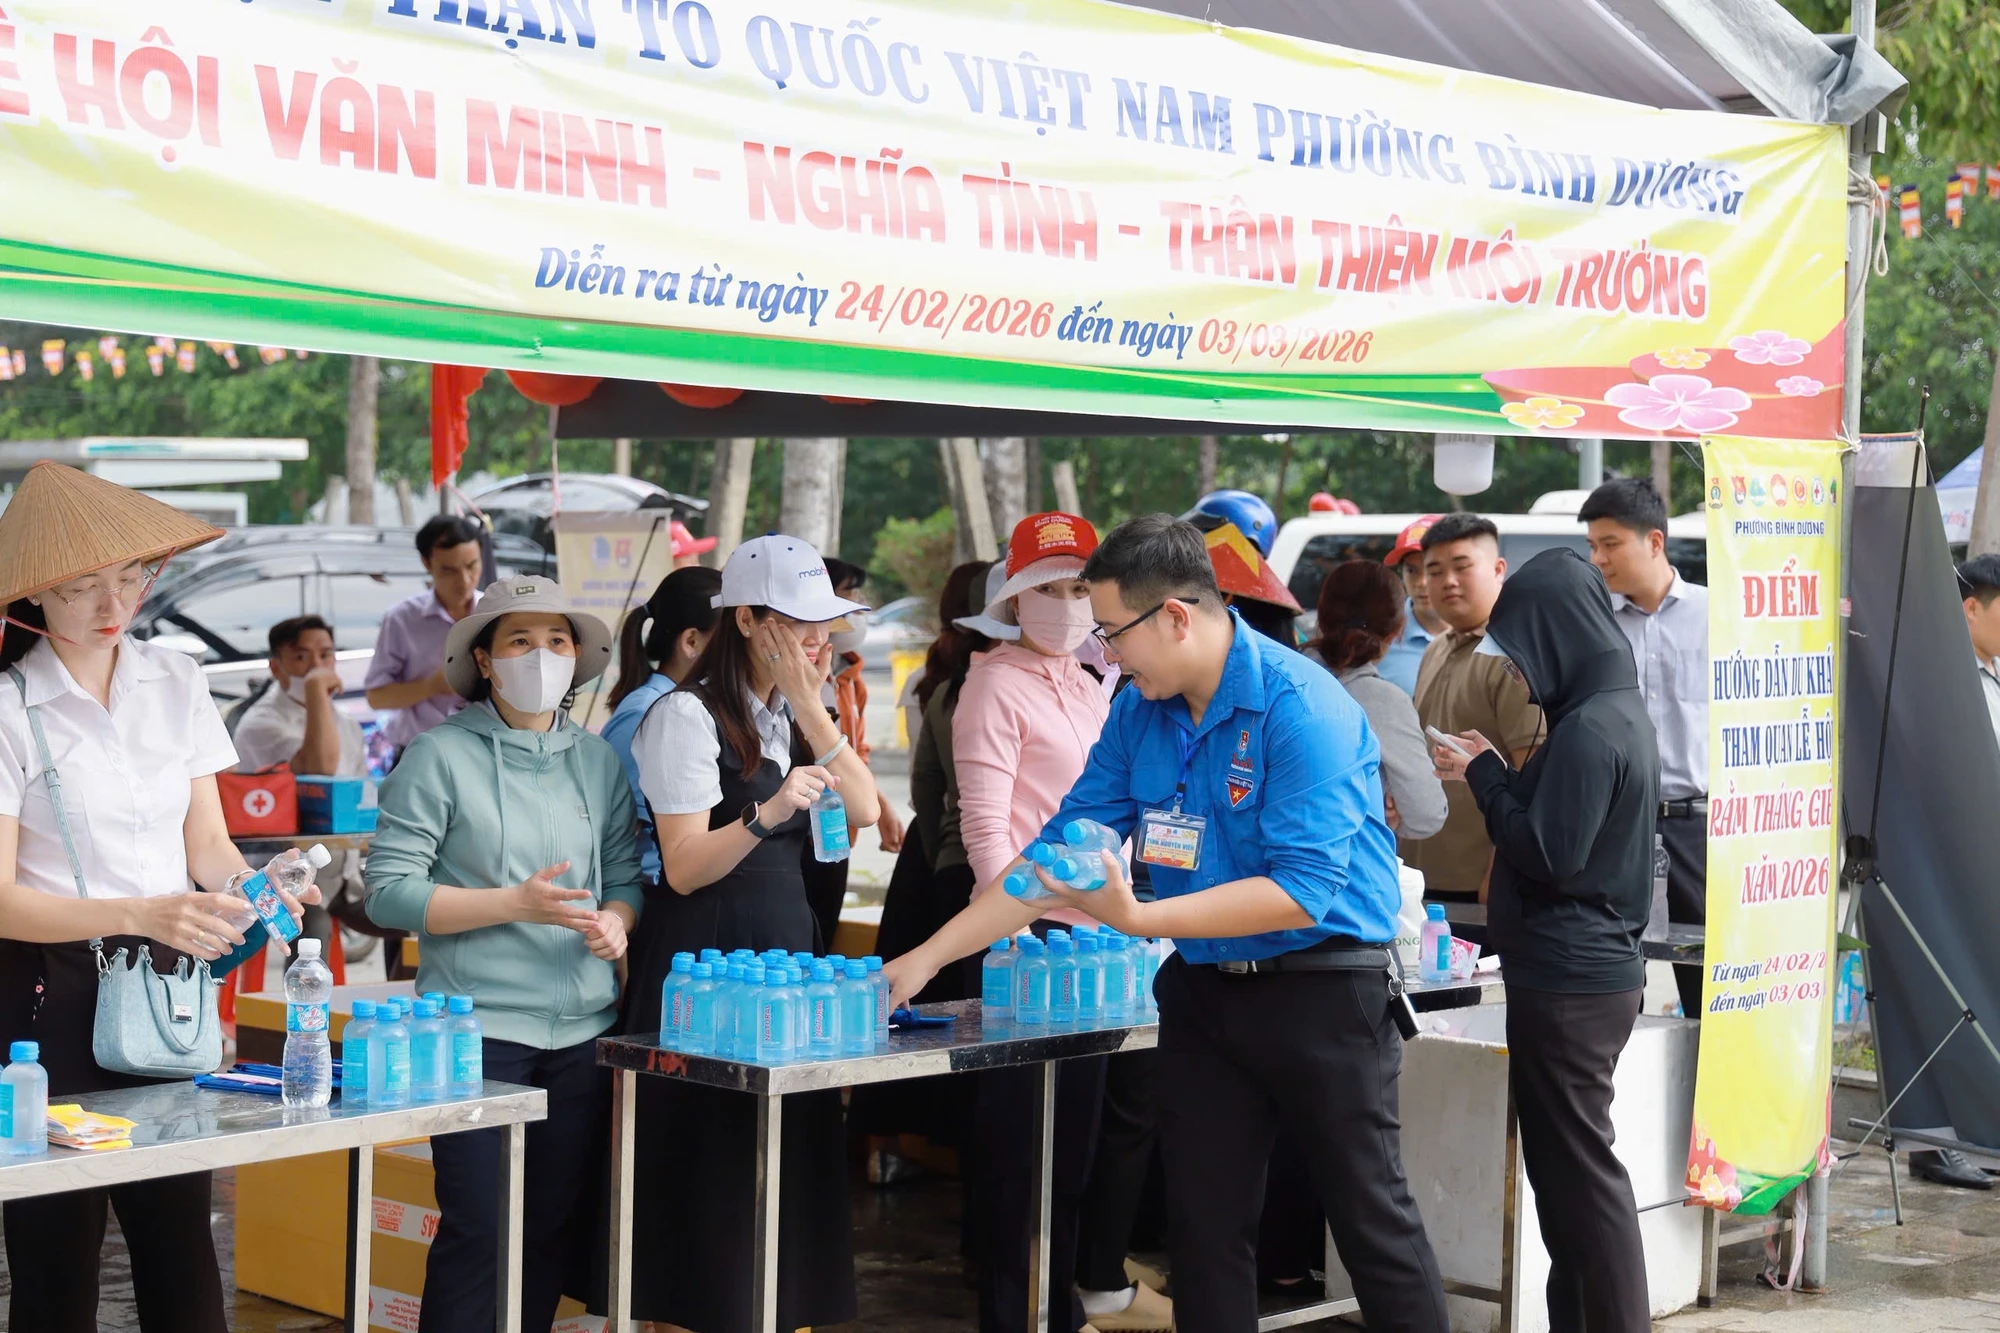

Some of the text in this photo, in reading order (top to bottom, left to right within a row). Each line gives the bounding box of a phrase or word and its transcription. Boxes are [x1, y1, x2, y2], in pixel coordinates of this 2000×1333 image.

[745, 16, 930, 104] QUỐC
[943, 50, 1092, 136] VIỆT
[1112, 77, 1236, 154] NAM
[1252, 102, 1467, 185] PHƯỜNG
[1474, 133, 1596, 205] BÌNH
[1605, 156, 1744, 216] DƯƠNG
[53, 25, 222, 164] HỘI
[254, 56, 437, 180] VĂN
[465, 97, 668, 209] MINH
[743, 140, 946, 244] NGHĨA
[962, 161, 1098, 262] TÌNH
[1159, 194, 1297, 284] THÂN
[1311, 213, 1439, 308] THIỆN
[1446, 229, 1542, 305] MÔI
[535, 243, 1375, 368] Diễn ra từ ngày 24/02/2026 đến ngày 03/03/2026
[1742, 558, 1820, 618] ĐIỂM
[1713, 644, 1834, 701] HƯỚNG DẪN DU KHÁ
[1722, 707, 1833, 769] THAM QUAN LỄ HỘ
[1709, 779, 1748, 837] RẰM
[1753, 782, 1804, 834] THÁNG
[1741, 853, 1829, 905] NĂM 2026
[1712, 962, 1730, 982] Từ
[1732, 959, 1762, 983] ngày
[672, 990, 682, 1027] NATURAL
[685, 995, 693, 1032] NATURAL
[815, 999, 823, 1037] NATURAL
[877, 988, 885, 1024] NATURAL
[1709, 990, 1735, 1012] đến
[1737, 987, 1767, 1012] ngày
